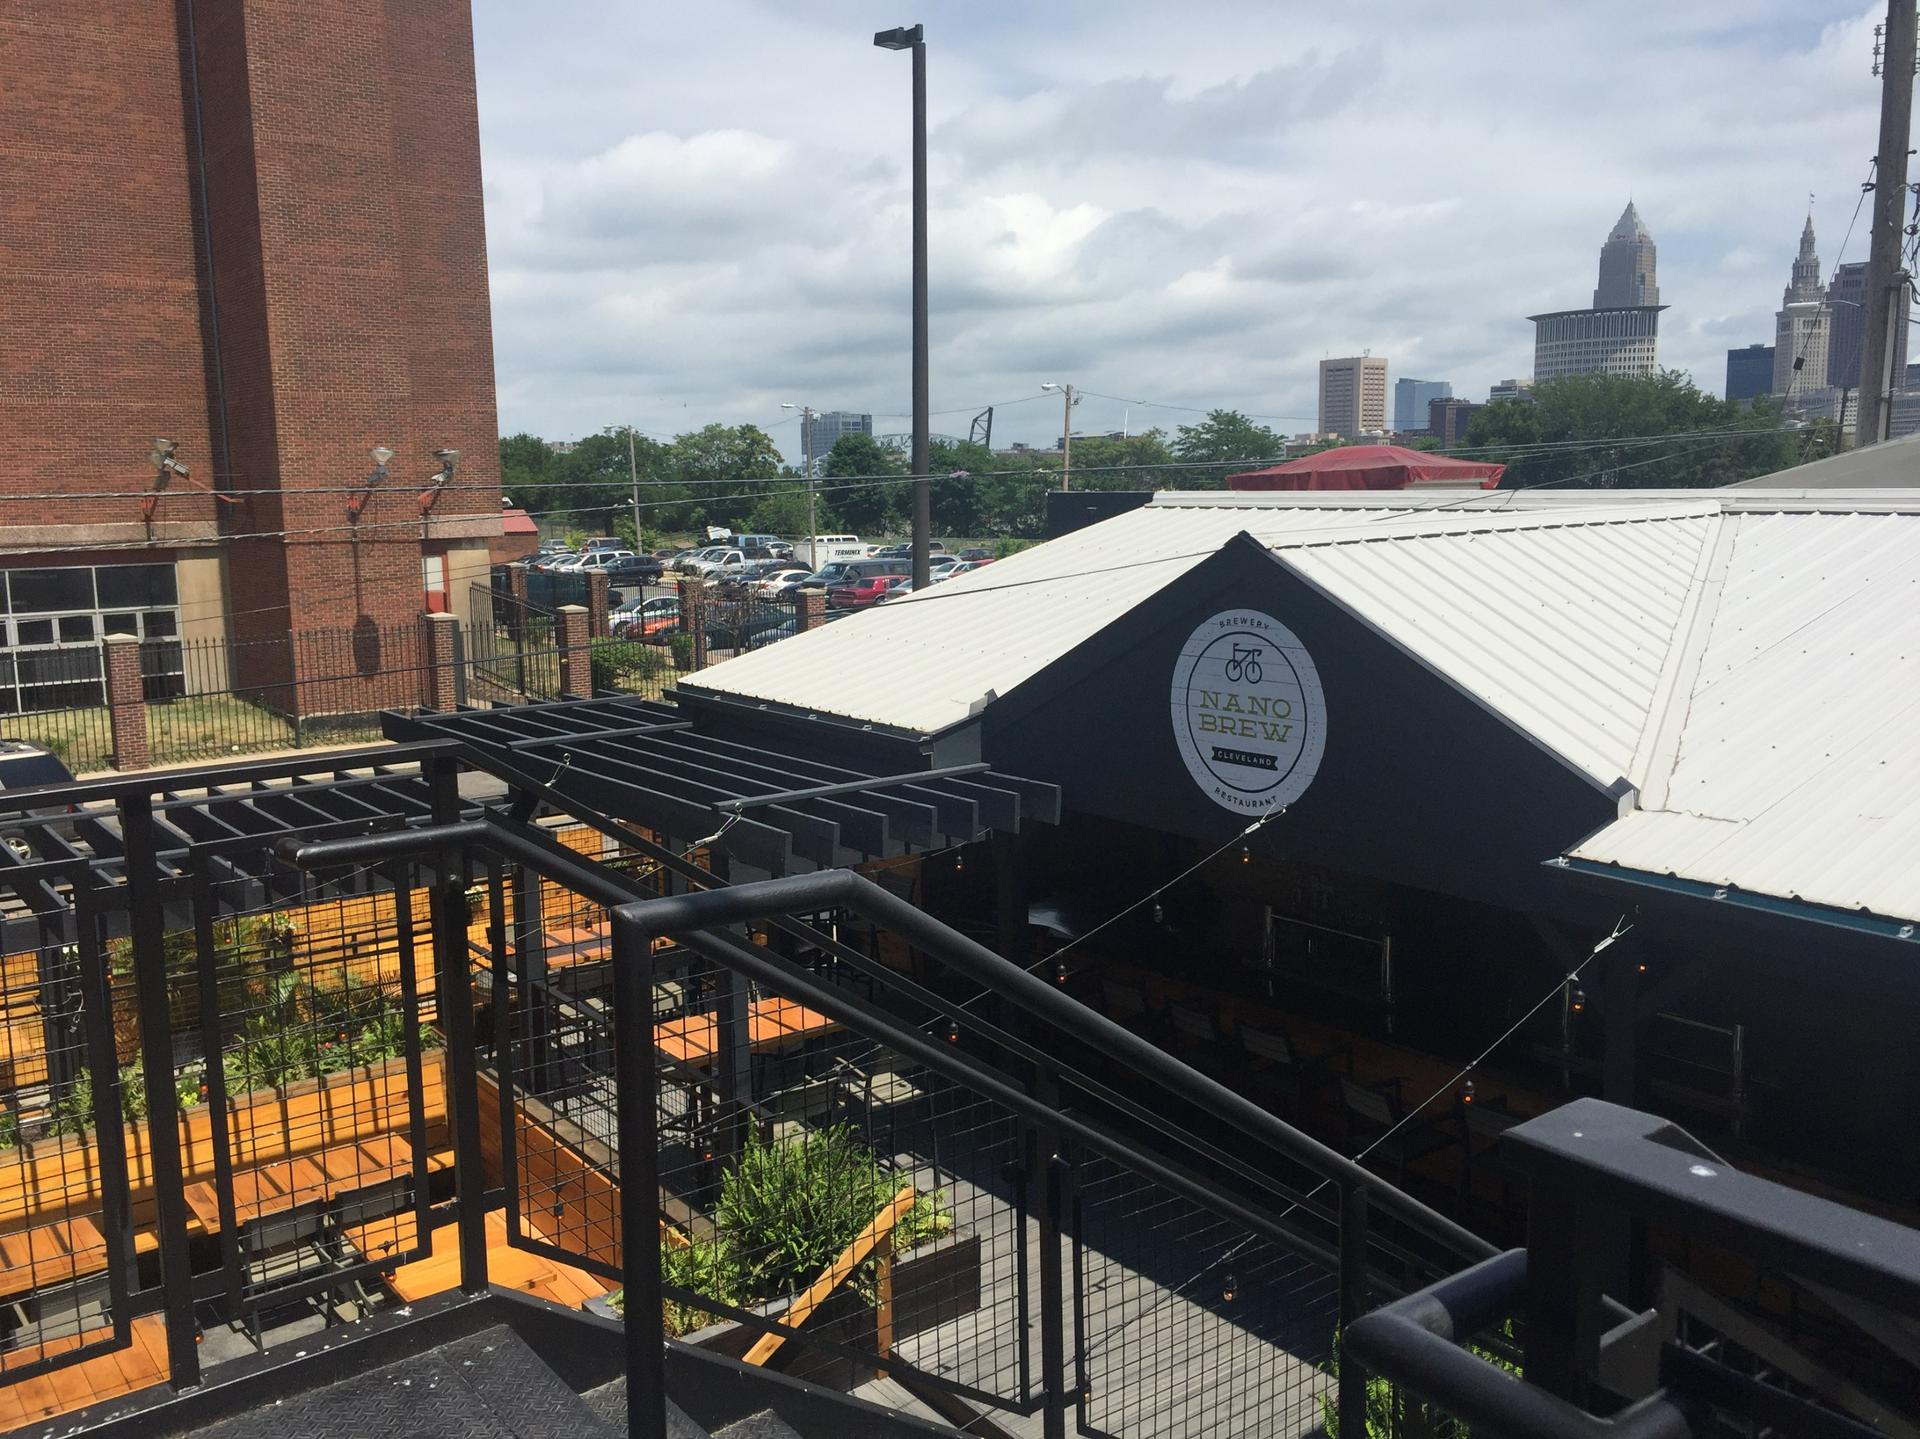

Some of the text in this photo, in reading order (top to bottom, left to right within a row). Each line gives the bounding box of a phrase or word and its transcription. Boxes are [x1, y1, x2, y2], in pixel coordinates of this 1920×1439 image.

[1219, 617, 1270, 630] BREWERY
[1199, 690, 1292, 719] NANO
[1198, 713, 1293, 743] BREW
[1217, 750, 1273, 767] CLEVELAND
[1214, 786, 1278, 808] RESTAURANT
